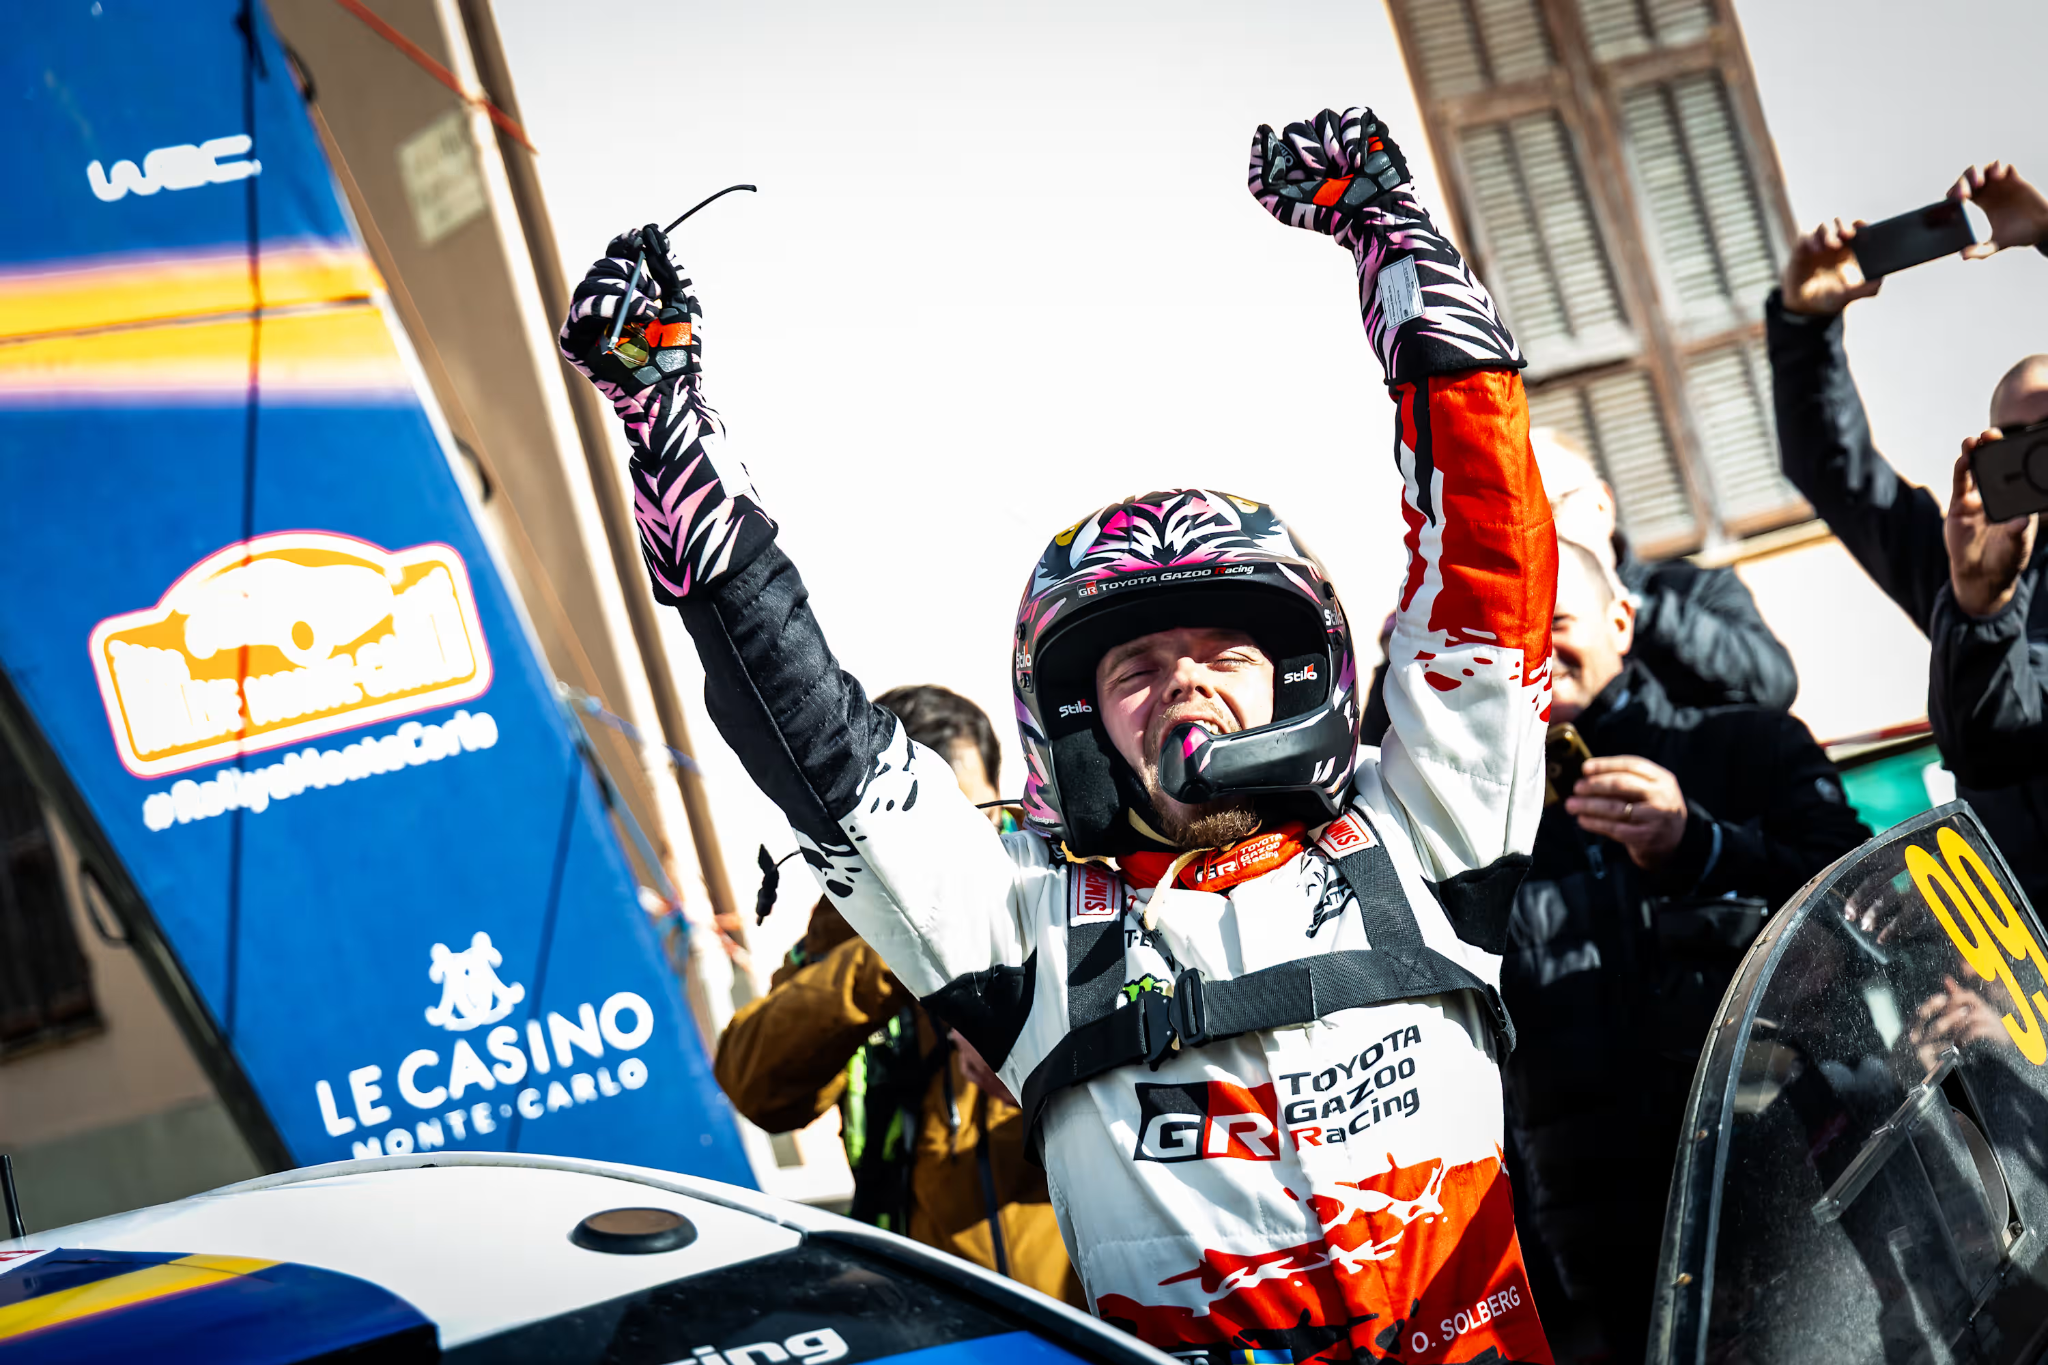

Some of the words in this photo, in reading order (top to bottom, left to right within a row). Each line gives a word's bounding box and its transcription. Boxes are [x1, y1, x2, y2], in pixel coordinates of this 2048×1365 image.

[1100, 575, 1157, 591] TOYOTA
[1160, 568, 1212, 581] GAZOO
[1214, 565, 1254, 576] Racing
[1284, 665, 1318, 684] Stilo
[1059, 700, 1093, 718] Stilo
[1240, 833, 1283, 854] TOYOTA
[1240, 842, 1280, 863] GAZOO
[316, 1064, 392, 1137] LE
[397, 991, 654, 1109] CASINO
[1279, 1024, 1422, 1096] TOYOTA
[1284, 1057, 1416, 1125] GAZOO
[1141, 1112, 1276, 1159] GR
[1290, 1087, 1420, 1152] Racing
[1440, 1285, 1521, 1342] SOLBERG
